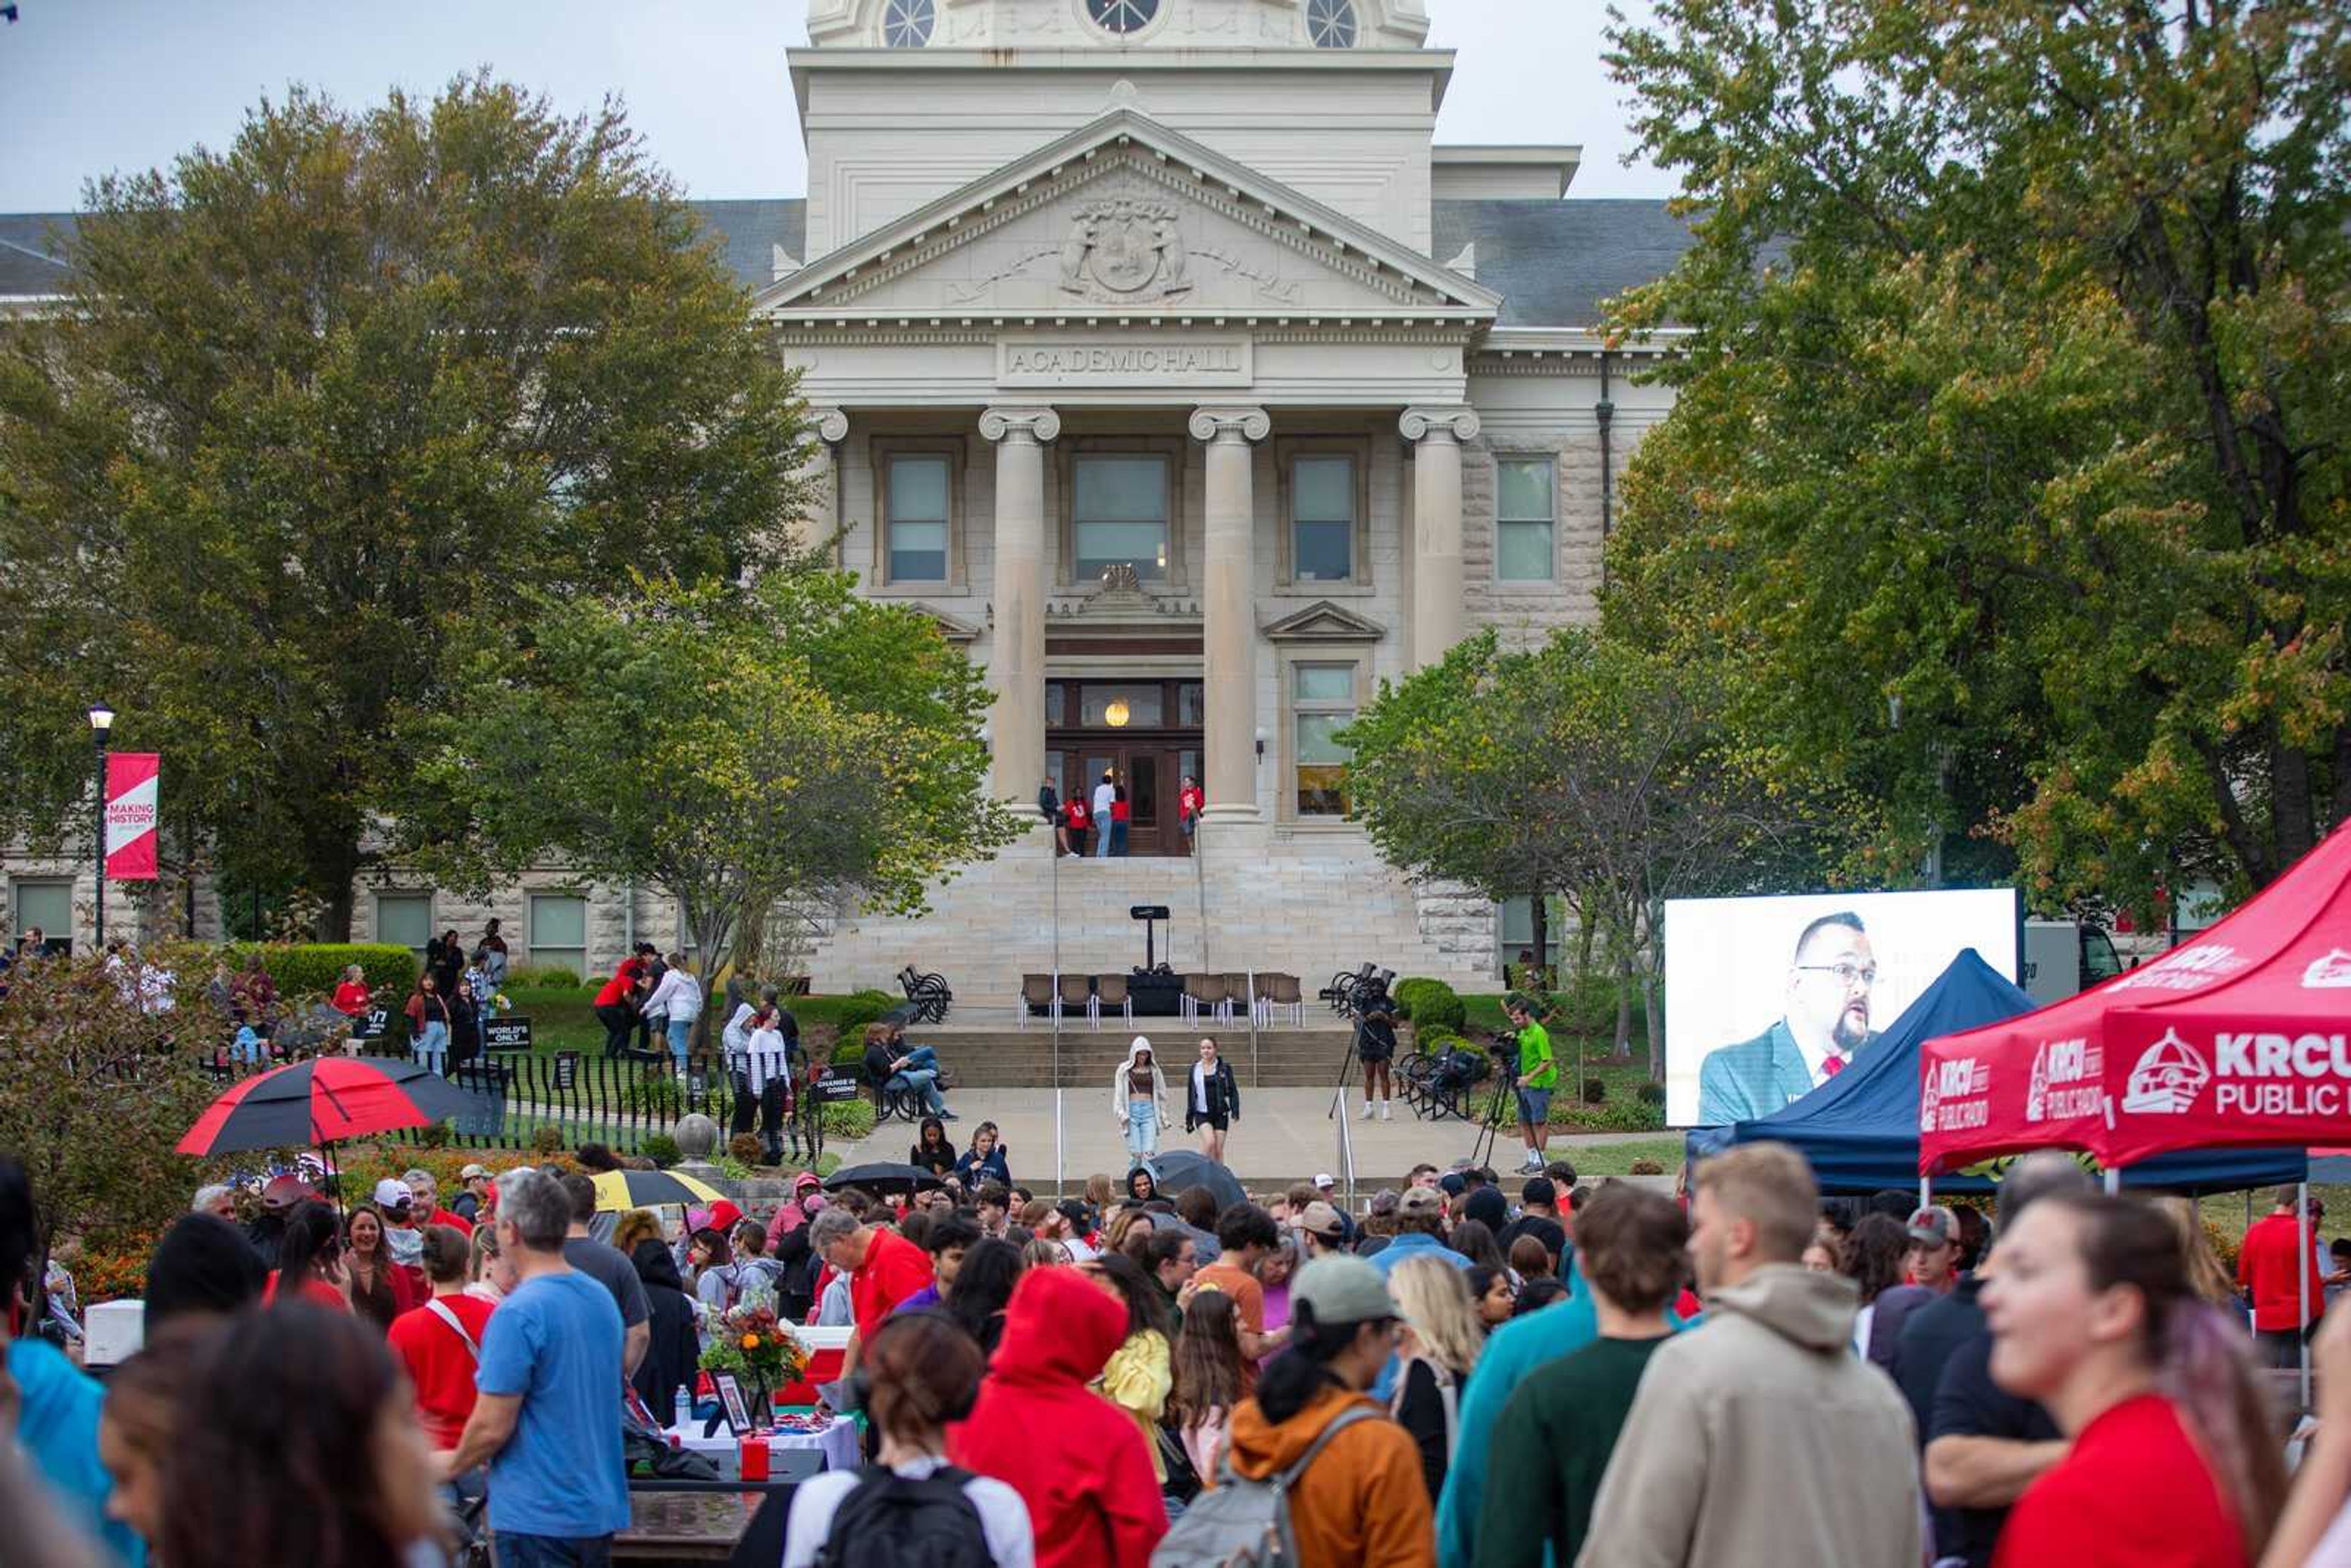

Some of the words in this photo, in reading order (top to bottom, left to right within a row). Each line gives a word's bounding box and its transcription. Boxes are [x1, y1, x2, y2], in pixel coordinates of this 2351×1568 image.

[1010, 350, 1160, 373] ACADEMIC
[1163, 350, 1240, 373] HALL
[109, 814, 155, 823] HISTORY
[110, 804, 154, 814] MAKING
[2214, 1033, 2351, 1077] KRCU
[2216, 1083, 2340, 1115] PUBLIC
